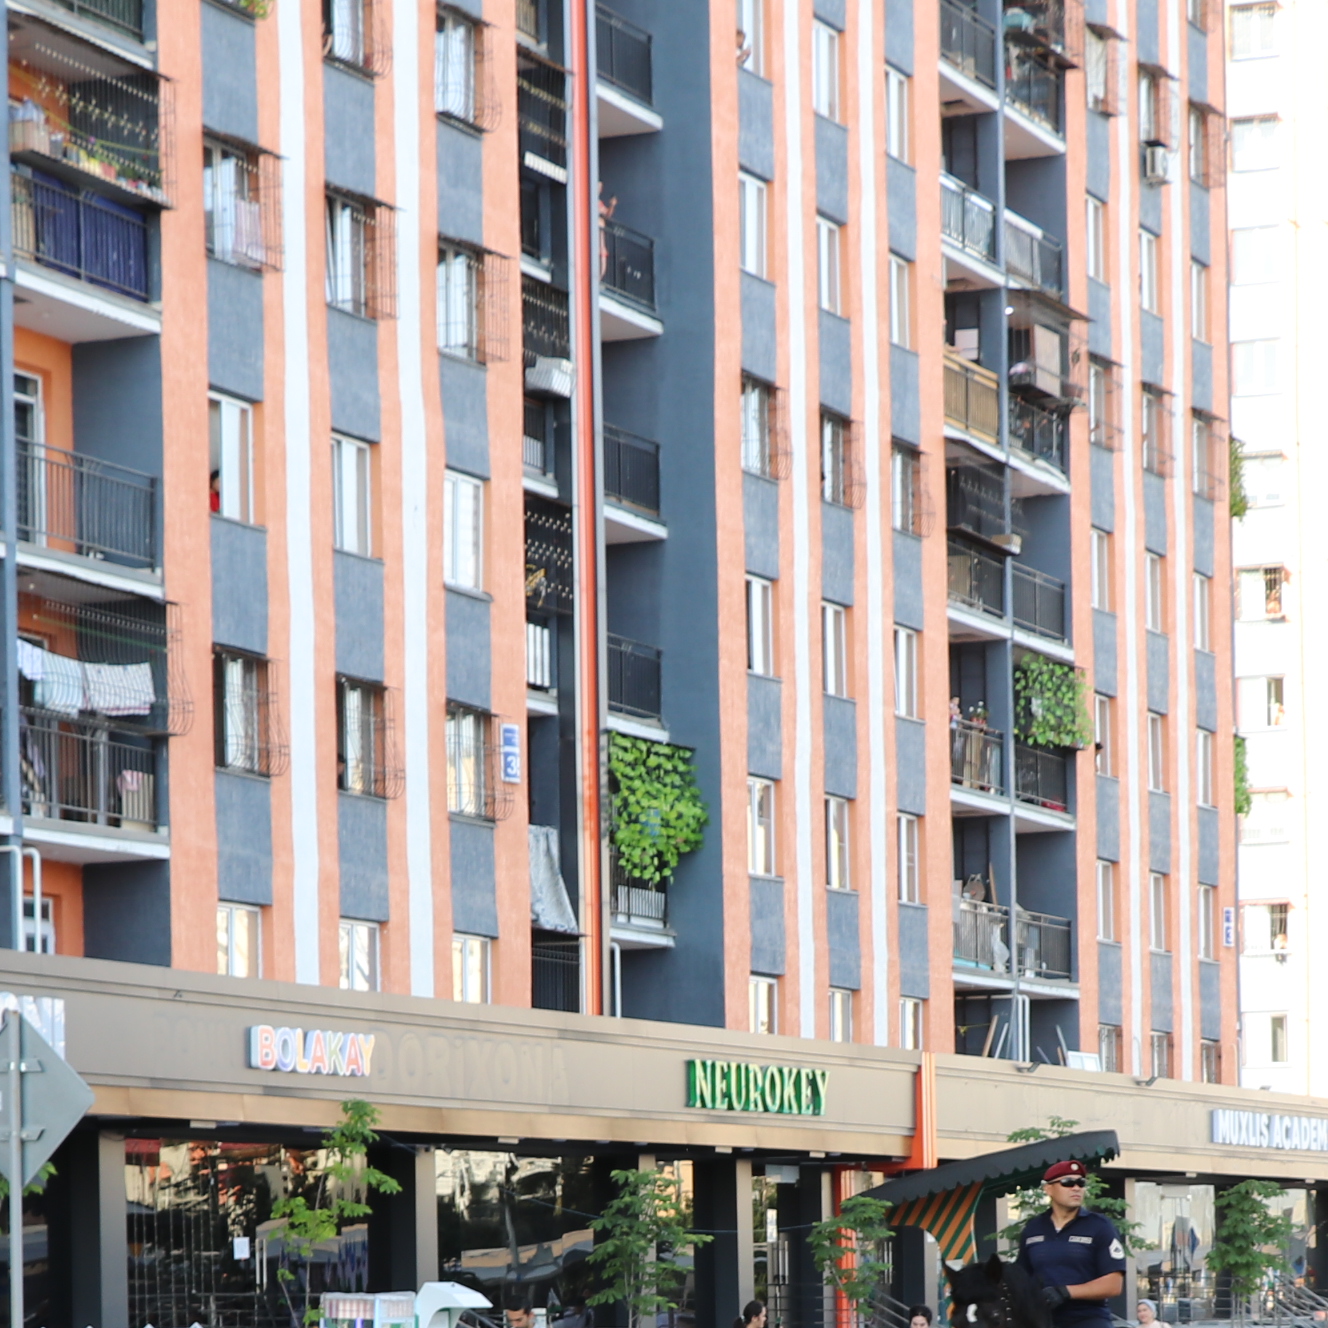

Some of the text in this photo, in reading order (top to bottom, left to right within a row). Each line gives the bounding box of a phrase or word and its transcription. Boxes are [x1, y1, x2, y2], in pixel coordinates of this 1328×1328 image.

[251, 1025, 375, 1077] BOLAKAY
[689, 1059, 831, 1116] NEUROKEY
[1214, 1109, 1269, 1148] MUXLIS
